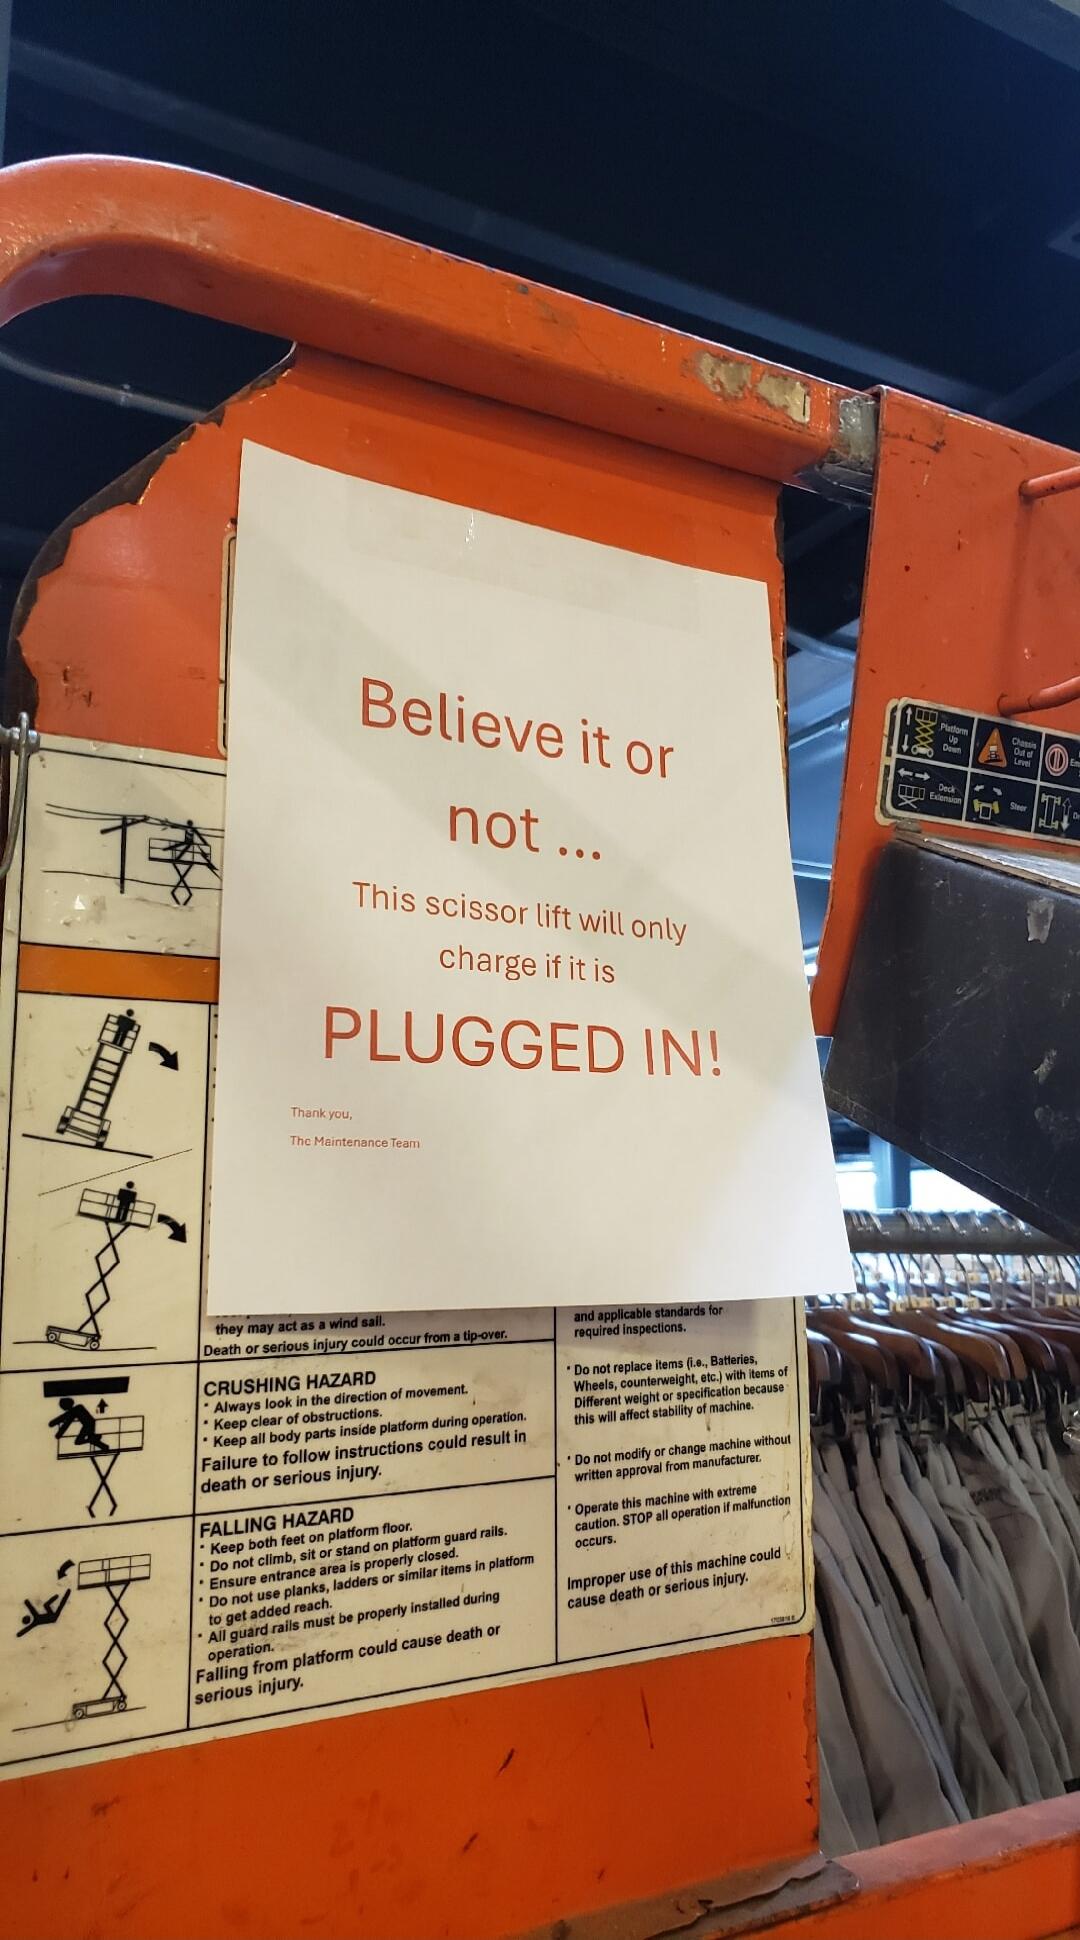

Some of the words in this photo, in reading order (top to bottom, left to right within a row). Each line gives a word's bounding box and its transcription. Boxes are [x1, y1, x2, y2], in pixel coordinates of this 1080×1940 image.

[362, 677, 563, 758] Believe
[583, 719, 610, 768] it
[627, 741, 674, 778] or
[940, 723, 968, 736] Platform
[949, 736, 958, 744] Up
[943, 744, 961, 754] Down
[1012, 738, 1037, 748] Chassis
[1014, 748, 1025, 757] Out
[1026, 749, 1033, 758] of
[1014, 757, 1031, 767] Level
[930, 792, 961, 805] Extension
[939, 783, 955, 793] Deck
[1010, 802, 1027, 812] Steer
[450, 806, 539, 852] not
[353, 881, 415, 912] This
[425, 894, 528, 925] scissor
[537, 903, 571, 930] lift
[579, 910, 624, 936] will
[631, 917, 687, 946] only
[440, 945, 536, 980] charge
[547, 954, 561, 978] if
[570, 956, 586, 980] it
[595, 958, 614, 983] is
[325, 1006, 624, 1073] PLUGGED
[645, 1029, 720, 1076] IN!
[291, 1107, 326, 1118] Thank
[329, 1110, 352, 1120] you,
[314, 1136, 388, 1148] Maintenance
[391, 1138, 420, 1148] Team
[216, 1324, 244, 1337] they
[248, 1324, 274, 1335] may
[278, 1321, 297, 1332] act
[301, 1322, 314, 1331] as
[319, 1321, 325, 1330] a
[330, 1317, 358, 1329] wind
[362, 1315, 385, 1327] sail.
[574, 1310, 594, 1322] and
[598, 1308, 651, 1323] applicable
[655, 1305, 705, 1318] standards
[709, 1305, 723, 1315] for
[204, 1345, 241, 1356] Death
[246, 1344, 257, 1354] or
[263, 1341, 309, 1353] serious
[313, 1339, 348, 1352] injury
[351, 1336, 384, 1348] could
[388, 1334, 421, 1346] occur
[424, 1331, 450, 1343] from
[454, 1333, 460, 1342] a
[464, 1329, 508, 1342] tip-over.
[575, 1324, 620, 1339] required
[623, 1322, 686, 1336] inspections.
[204, 1376, 300, 1396] CRUSHING
[307, 1371, 376, 1389] HAZARD
[574, 1379, 617, 1392] Wheels,
[621, 1373, 698, 1388] counterweight,
[701, 1371, 722, 1384] etc.)
[726, 1369, 746, 1381] with
[749, 1369, 775, 1379] items
[778, 1366, 788, 1376] of
[214, 1401, 260, 1414] Always
[266, 1397, 292, 1409] look
[297, 1396, 307, 1407] in
[311, 1394, 330, 1406] the
[335, 1391, 386, 1404] direction
[391, 1388, 402, 1400] of
[406, 1384, 468, 1398] movement.
[575, 1395, 621, 1408] Different
[625, 1392, 660, 1405] weight
[663, 1393, 673, 1401] or
[677, 1386, 740, 1402] specification
[744, 1384, 784, 1395] because
[214, 1419, 247, 1431] Keep
[251, 1416, 282, 1427] clear
[287, 1413, 299, 1425] of
[303, 1408, 382, 1423] obstructions.
[575, 1413, 594, 1425] this
[598, 1411, 616, 1423] will
[620, 1409, 649, 1421] affect
[653, 1404, 693, 1418] stability
[697, 1403, 706, 1414] of
[710, 1400, 754, 1413] machine.
[202, 1456, 257, 1472] Failure
[263, 1454, 278, 1466] to
[283, 1449, 330, 1465] follow
[336, 1441, 423, 1459] instructions
[428, 1435, 466, 1450] could
[472, 1431, 510, 1446] result
[515, 1430, 526, 1443] in
[201, 1476, 246, 1493] death
[252, 1476, 269, 1488] or
[274, 1470, 330, 1486] serious
[337, 1465, 381, 1482] injury.
[575, 1469, 612, 1482] written
[616, 1462, 662, 1479] approval
[666, 1461, 689, 1472] from
[575, 1501, 618, 1517] Operate
[622, 1497, 641, 1509] this
[646, 1492, 689, 1506] machine
[693, 1488, 714, 1500] with
[717, 1485, 756, 1497] extreme
[575, 1518, 619, 1531] caution.
[623, 1512, 652, 1526] STOP
[656, 1509, 668, 1521] all
[672, 1505, 720, 1521] operation
[724, 1502, 730, 1512] if
[733, 1496, 790, 1511] malfunction
[201, 1516, 276, 1538] FALLING
[283, 1507, 354, 1529] HAZARD
[211, 1543, 244, 1555] Keep
[249, 1536, 277, 1550] both
[281, 1534, 305, 1546] feet
[309, 1534, 324, 1543] on
[329, 1527, 378, 1544] platform
[383, 1523, 412, 1534] floor.
[576, 1536, 616, 1548] occurs.
[210, 1576, 256, 1590] Ensure
[261, 1568, 316, 1583] entrance
[320, 1565, 346, 1576] area
[350, 1561, 360, 1571] is
[365, 1554, 414, 1572] properly
[418, 1547, 458, 1563] closed.
[568, 1572, 626, 1591] Improper
[630, 1569, 651, 1581] use
[656, 1563, 667, 1576] of
[671, 1560, 692, 1574] this
[697, 1554, 746, 1571] machine
[750, 1547, 780, 1562] could
[568, 1595, 605, 1609] cause
[610, 1586, 644, 1602] death
[649, 1586, 661, 1596] or
[665, 1578, 709, 1594] serious
[713, 1572, 748, 1588] injury.
[209, 1615, 222, 1625] to
[226, 1610, 246, 1626] get
[250, 1603, 290, 1619] added
[294, 1598, 332, 1613] reach.
[196, 1666, 248, 1684] Falling
[253, 1659, 288, 1674] from
[293, 1649, 353, 1671] platform
[359, 1639, 397, 1657] could
[402, 1635, 442, 1650] cause
[447, 1626, 482, 1643] death
[487, 1626, 500, 1636] or
[208, 1643, 274, 1663] operation.
[195, 1686, 252, 1705] serious
[259, 1677, 303, 1695] injury.
